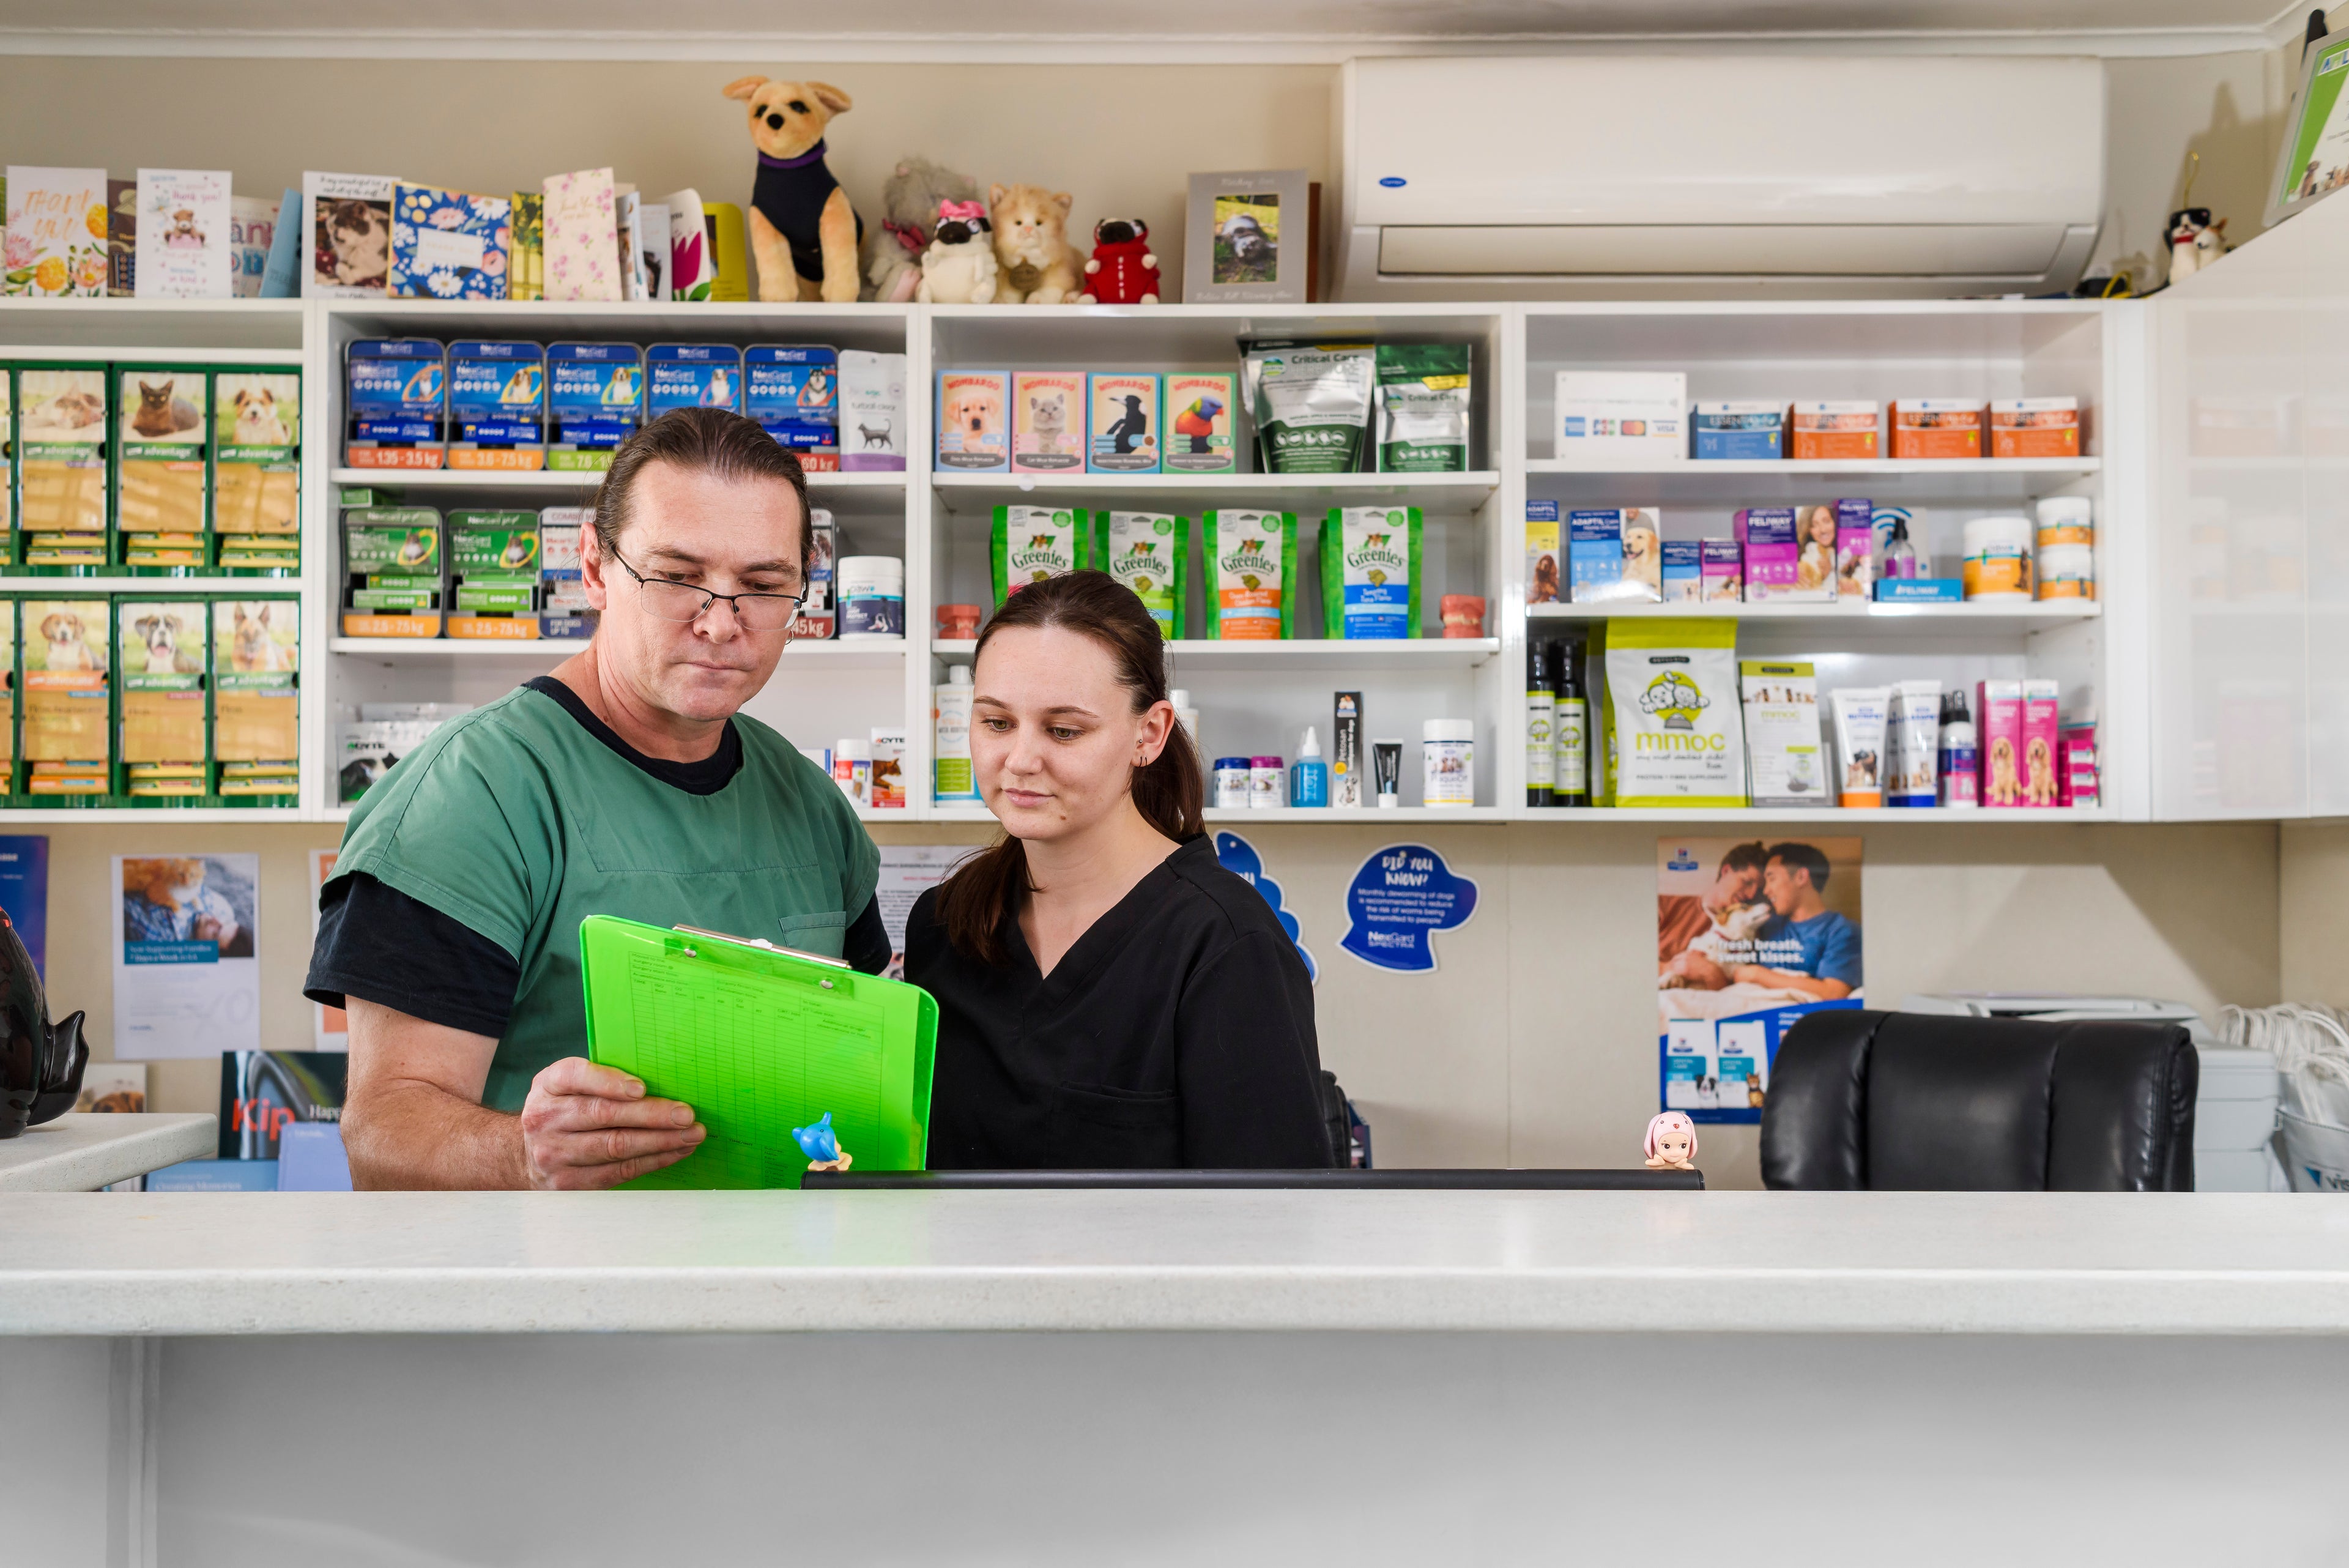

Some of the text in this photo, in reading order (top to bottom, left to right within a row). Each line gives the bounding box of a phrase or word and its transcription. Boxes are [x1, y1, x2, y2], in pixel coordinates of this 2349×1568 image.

[1291, 353, 1359, 364] Critical Care
[456, 365, 497, 374] NexGard
[556, 368, 596, 377] NexGard
[655, 370, 695, 378] NexGard
[43, 445, 91, 458] advantage
[144, 445, 192, 459] advantage
[237, 447, 285, 461] advantage
[377, 451, 437, 468] 1.35 3.5 kg
[502, 453, 517, 466] 7.5
[519, 453, 532, 469] kg
[820, 458, 834, 472] kg
[1748, 517, 1792, 527] FELIWAY
[1012, 549, 1069, 569] Greenies
[1221, 555, 1277, 574] Greenies
[1347, 548, 1405, 568] Greenies
[1113, 557, 1168, 576] Greenies
[1906, 586, 1940, 595] FELIWAY
[412, 619, 424, 635] kg
[514, 622, 527, 636] kg
[808, 619, 825, 638] kg
[46, 675, 95, 686] advocate
[145, 675, 192, 689] advantage
[237, 674, 284, 688] advantage
[1761, 710, 1800, 720] mmoc
[1636, 732, 1726, 752] mmoc
[1382, 856, 1433, 872] DID YOU
[1386, 871, 1429, 886] KNOW?
[1357, 888, 1385, 897] Monthly
[1387, 890, 1427, 899] deworming
[1436, 891, 1455, 900] dogs
[1424, 908, 1445, 918] being
[1368, 931, 1415, 942] NexGard
[1718, 951, 1805, 964] sweet kisses.
[232, 1098, 296, 1142] Kip
